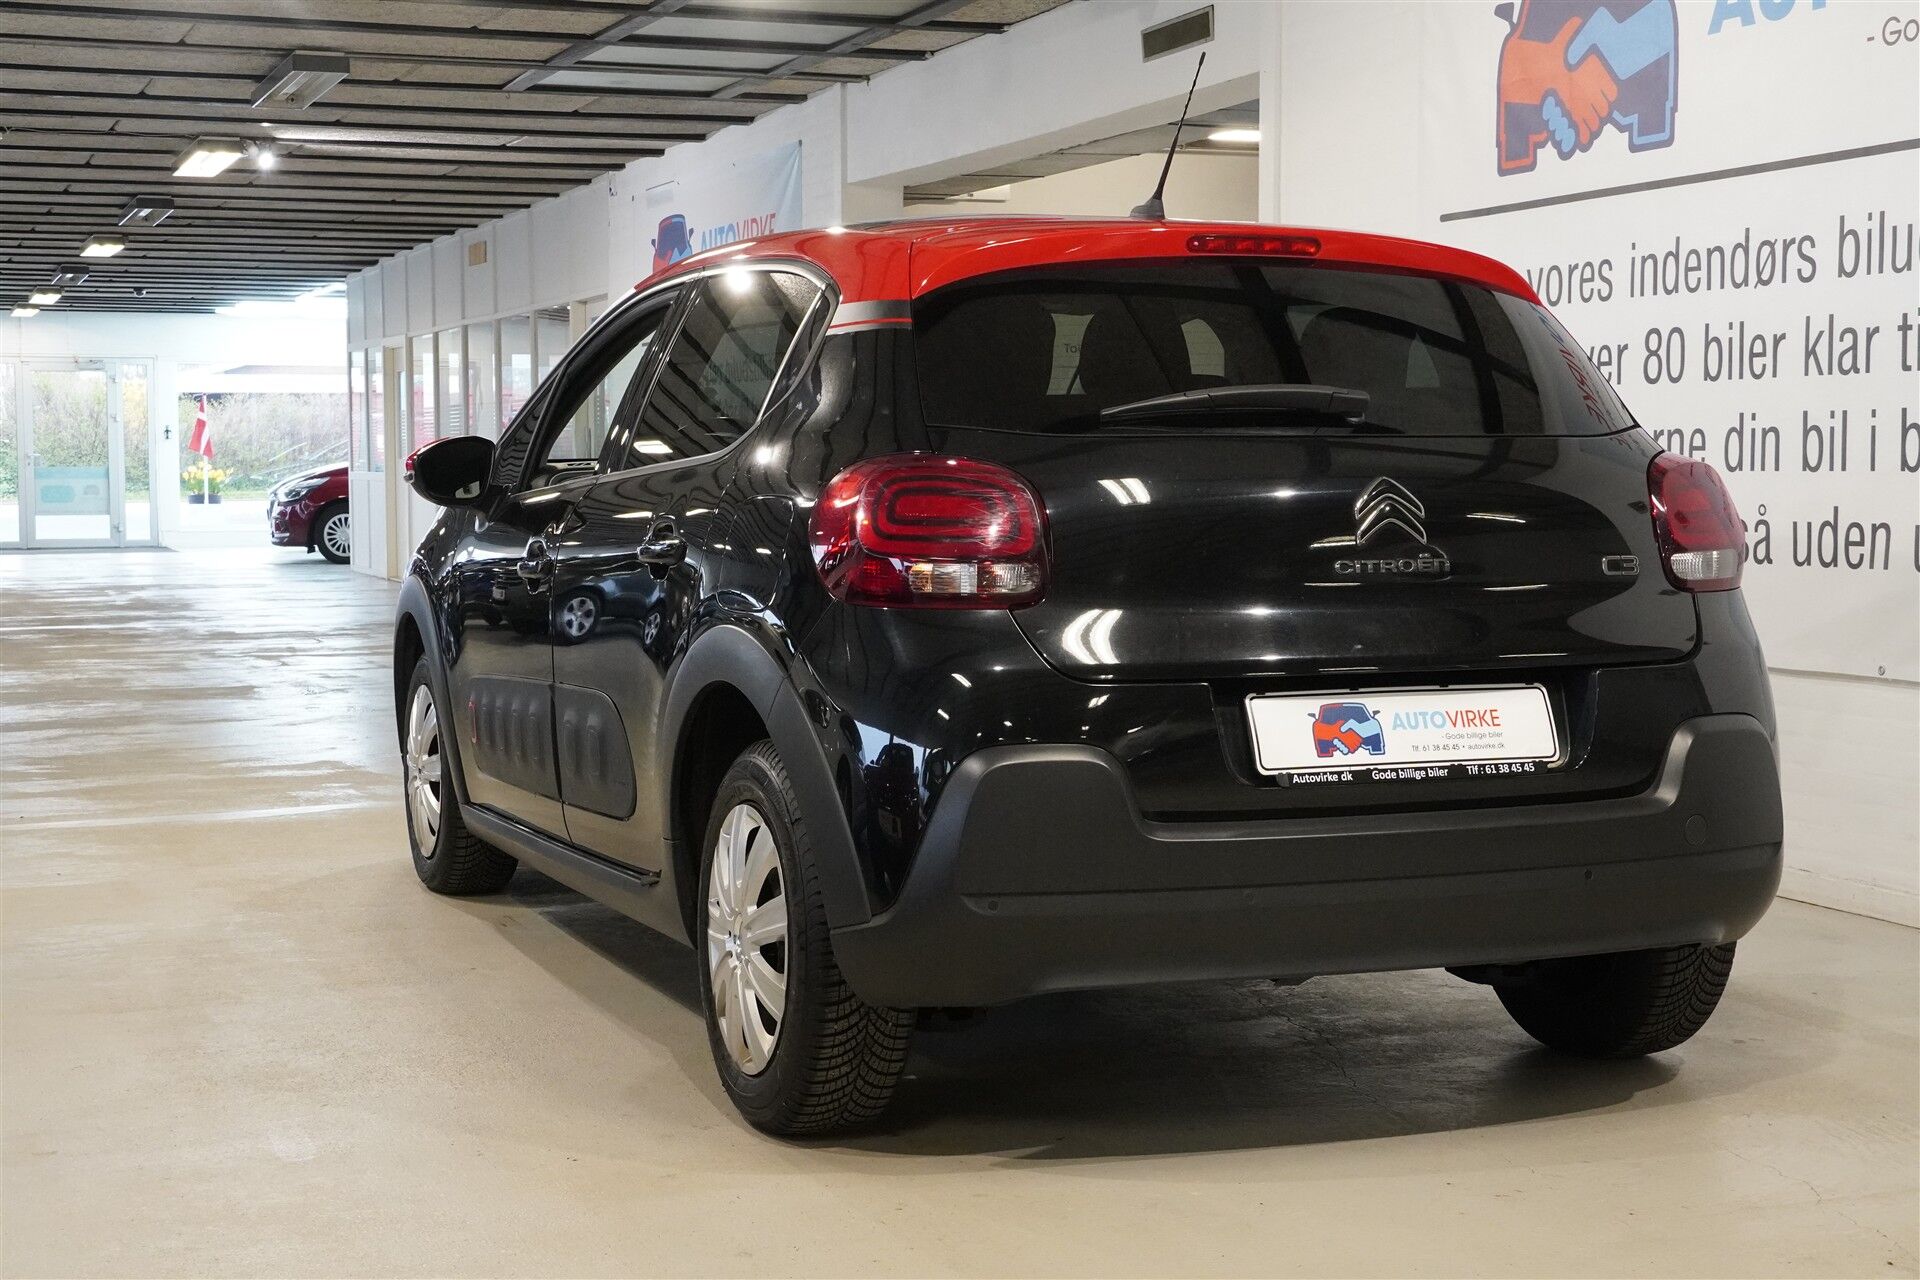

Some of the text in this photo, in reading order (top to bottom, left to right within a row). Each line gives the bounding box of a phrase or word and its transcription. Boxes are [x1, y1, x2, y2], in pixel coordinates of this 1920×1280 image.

[1630, 227, 1817, 298] indendørs
[1837, 210, 1920, 279] bilu
[1643, 326, 1686, 385] 80
[1703, 321, 1787, 383] biler
[1804, 313, 1880, 377] klar
[1724, 412, 1781, 473] din
[1801, 409, 1848, 473] bil
[1870, 408, 1877, 472] i
[1792, 505, 1892, 571] uden
[1602, 555, 1640, 576] C3
[1392, 709, 1501, 731] AUTOVIRKE
[1445, 732, 1465, 740] Gode
[1466, 731, 1487, 740] billige
[1488, 730, 1503, 739] biler
[1452, 743, 1460, 751] 45
[1292, 772, 1339, 784] Autovirke
[1341, 771, 1354, 781] dk
[1371, 769, 1397, 780] Gode
[1398, 768, 1426, 780] billige
[1427, 767, 1448, 777] biler
[1485, 764, 1497, 774] 61
[1498, 764, 1510, 773] 38
[1511, 763, 1522, 772] 45
[1523, 762, 1535, 772] 45
